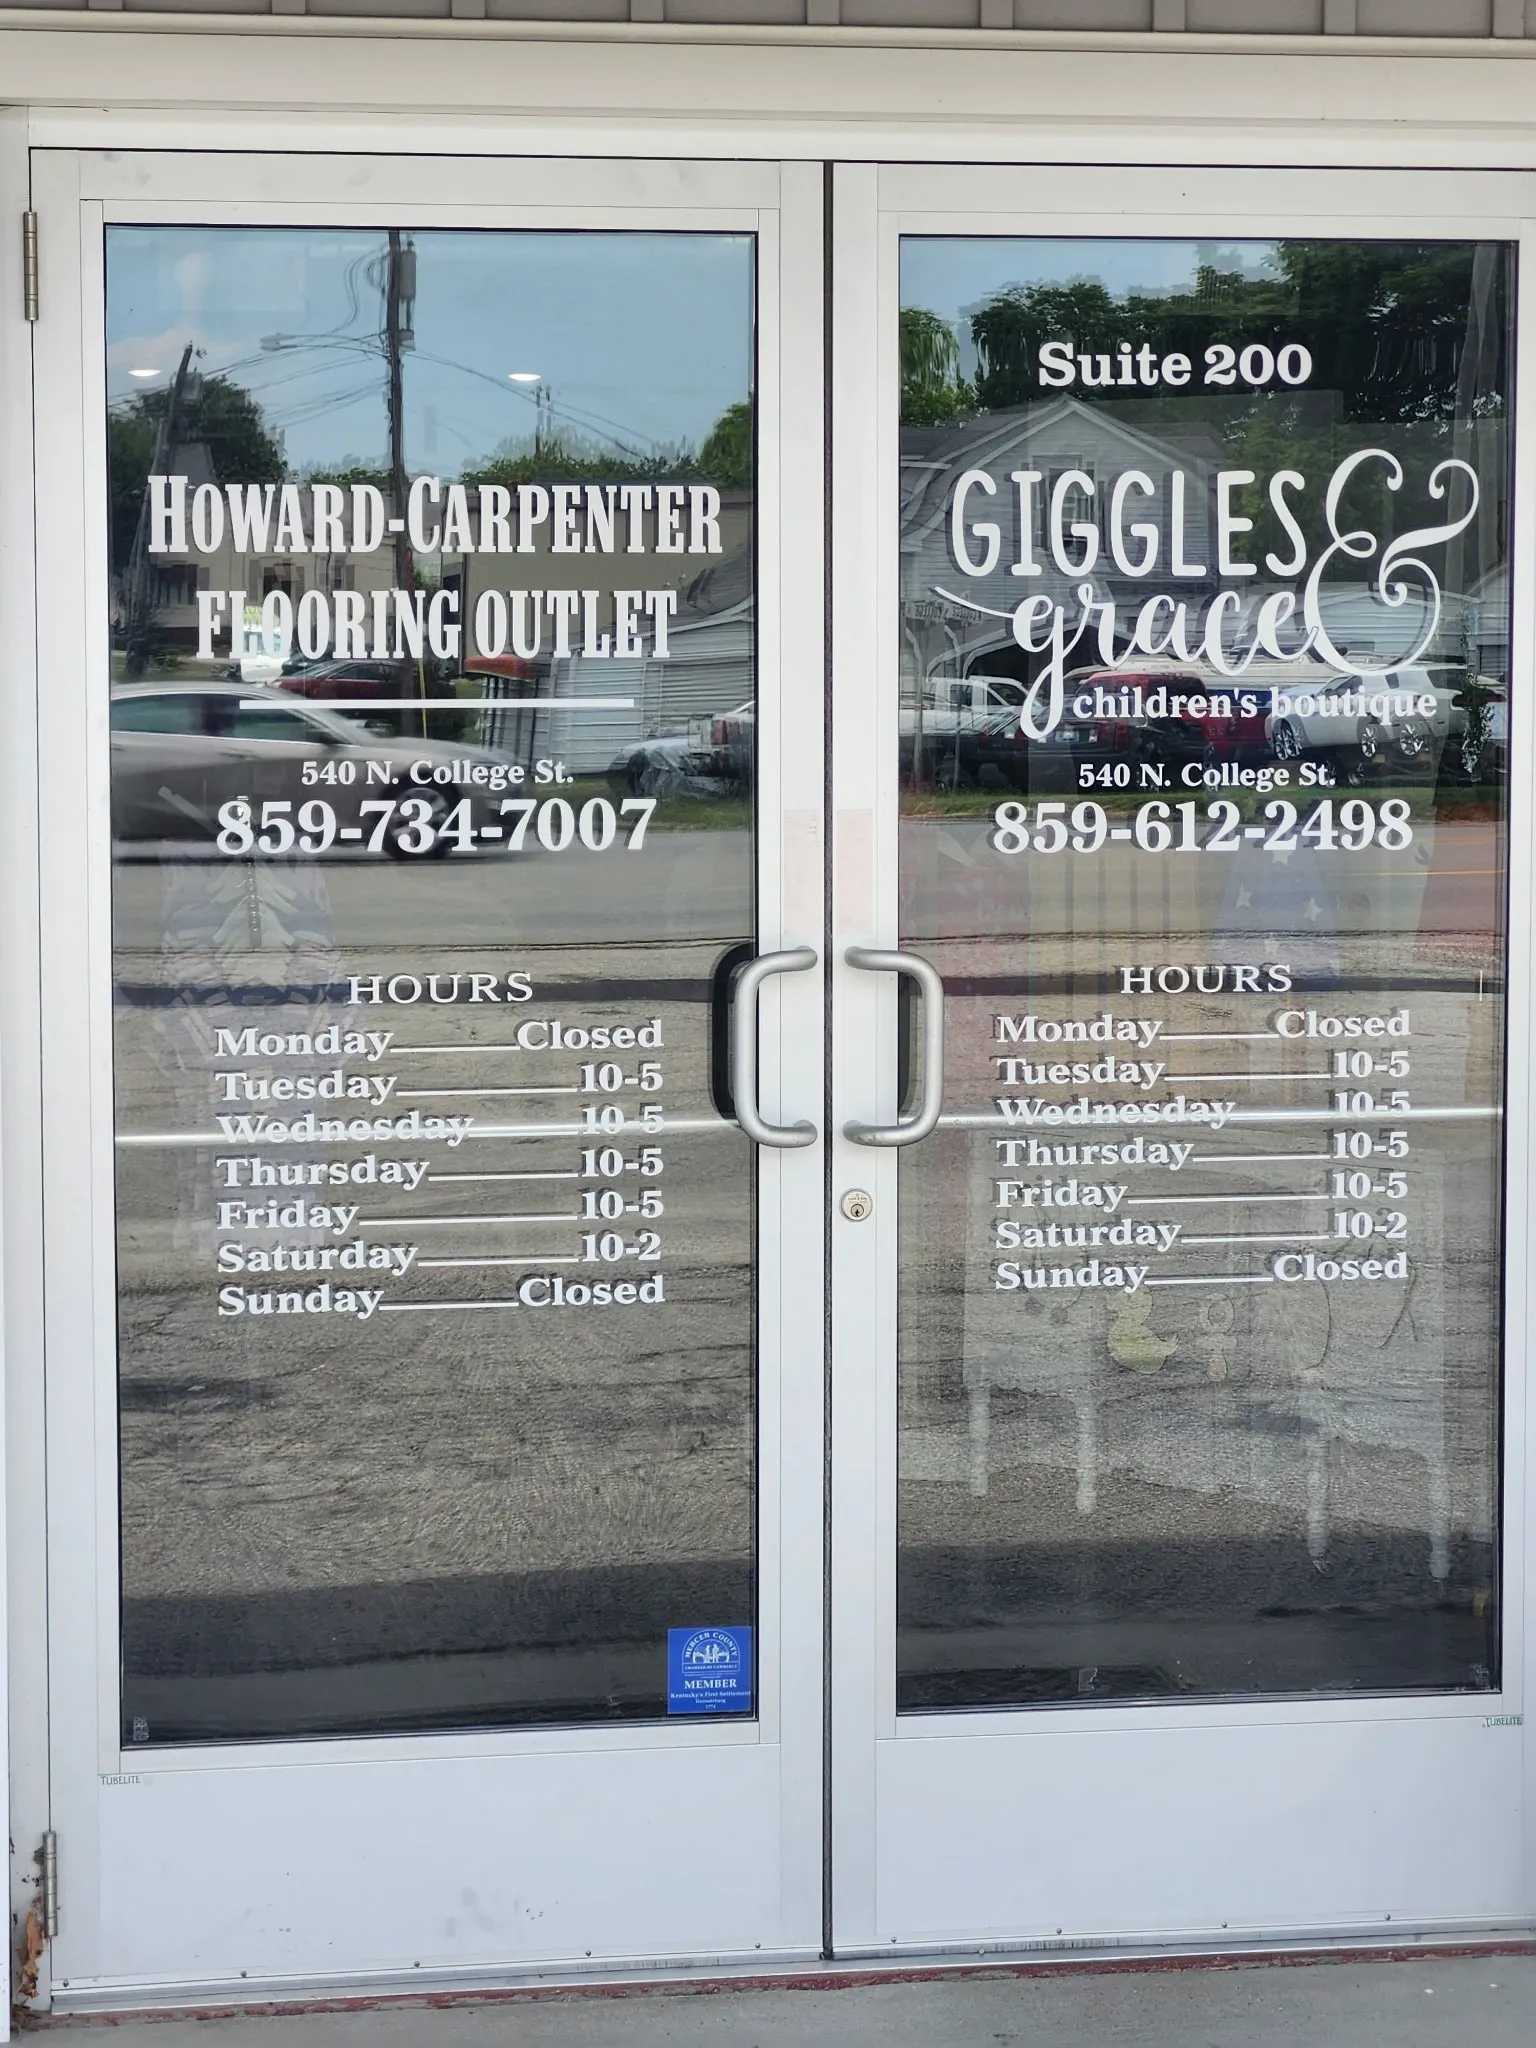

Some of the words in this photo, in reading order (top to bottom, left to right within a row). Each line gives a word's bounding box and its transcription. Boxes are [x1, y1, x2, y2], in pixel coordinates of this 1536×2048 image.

[1038, 341, 1192, 387] Suite
[1203, 343, 1313, 386] 200
[951, 469, 1307, 577] GIGGLES
[196, 589, 462, 660] FLOORING
[475, 589, 678, 660] OUTLET
[934, 582, 1319, 740] grace
[1072, 686, 1258, 720] children's
[1271, 686, 1438, 720] boutique
[300, 760, 357, 787] 540
[365, 760, 400, 786] N.
[409, 759, 526, 791] College
[534, 759, 574, 784] St.
[1077, 763, 1131, 788] 540
[1138, 763, 1172, 787] N.
[1180, 761, 1290, 792] College
[1298, 761, 1337, 786] St.
[215, 797, 658, 855] 859-734-7007
[992, 798, 1414, 855] 859-612-2498
[346, 972, 534, 1005] HOURS
[1120, 964, 1293, 995] HOURS
[213, 1025, 394, 1062] Monday
[516, 1019, 665, 1051] Closed
[996, 1013, 1163, 1048] Monday
[1275, 1009, 1412, 1039] Closed
[215, 1069, 398, 1106] Tuesday
[580, 1062, 663, 1093] 10-5
[996, 1055, 1166, 1090] Tuesday
[1332, 1050, 1410, 1078] 10-5
[216, 1109, 474, 1147] Wednesday
[581, 1105, 664, 1135] 10-5
[996, 1095, 1236, 1130] Wednesday
[1333, 1091, 1411, 1119] 10-5
[216, 1154, 430, 1190] Thursday
[580, 1147, 664, 1177] 10-5
[996, 1136, 1195, 1171] Thursday
[1332, 1131, 1410, 1160] 10-5
[216, 1198, 360, 1235] Friday
[580, 1190, 664, 1220] 10-5
[995, 1178, 1129, 1213] Friday
[1331, 1171, 1409, 1200] 10-5
[995, 1218, 1183, 1253] Saturday
[1332, 1211, 1408, 1240] 10-2
[216, 1240, 419, 1276] Saturday
[581, 1232, 662, 1262] 10-2
[995, 1259, 1150, 1294] Sunday
[1272, 1252, 1409, 1282] Closed
[217, 1283, 385, 1320] Sunday
[518, 1275, 665, 1308] Closed
[684, 1632, 711, 1659] MERCER
[712, 1632, 738, 1656] COUNTY
[684, 1678, 737, 1689] MEMBER
[1486, 1716, 1522, 1727] TUBELITE
[101, 1775, 141, 1785] TUBELITE
